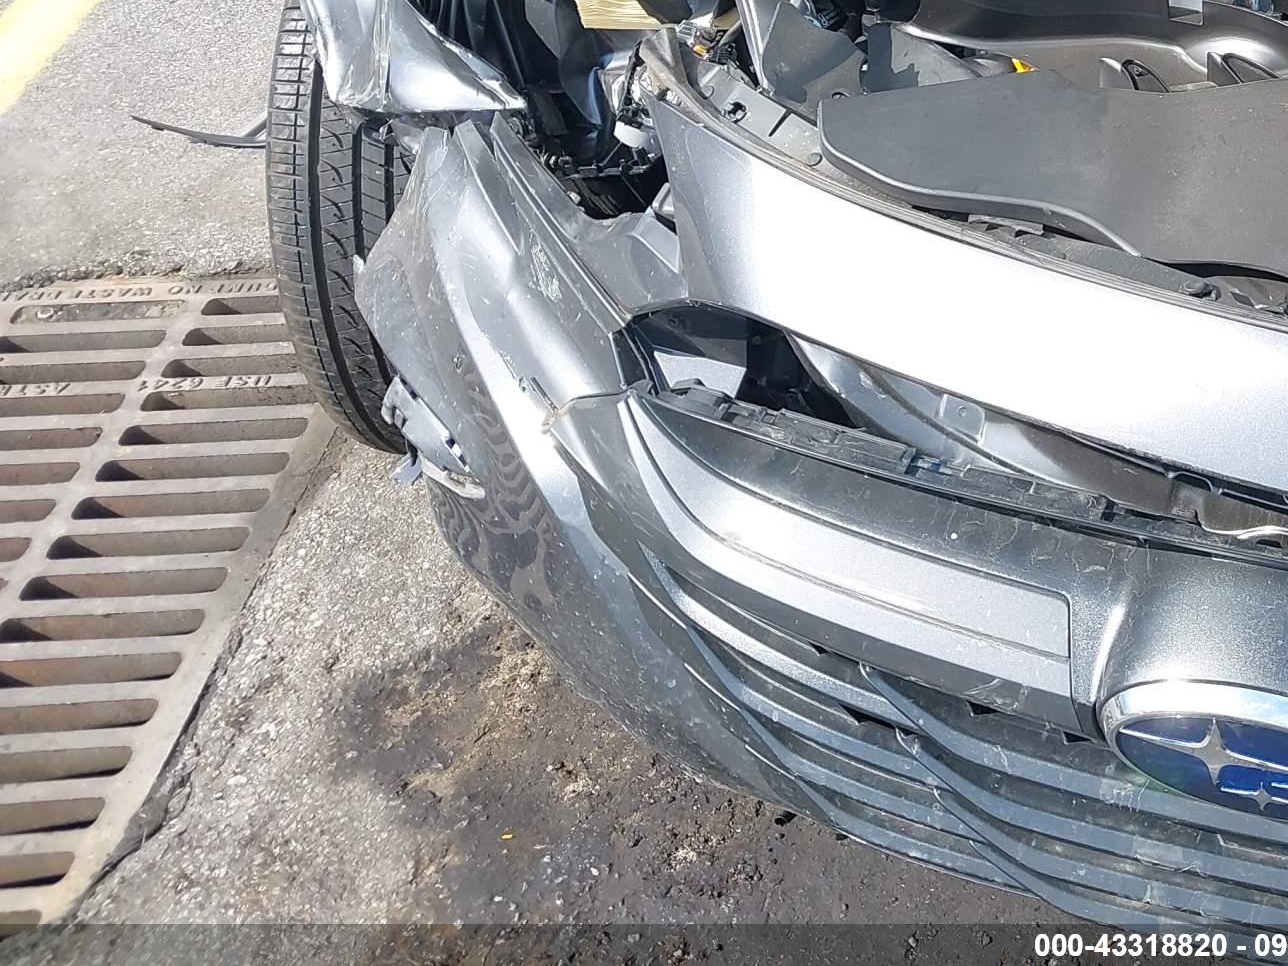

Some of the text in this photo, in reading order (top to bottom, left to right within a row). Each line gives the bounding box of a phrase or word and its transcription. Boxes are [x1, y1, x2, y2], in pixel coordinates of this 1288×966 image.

[71, 286, 153, 299] WASTE
[166, 284, 202, 296] NO
[211, 281, 278, 294] DUMP
[136, 375, 272, 392] USF 6241
